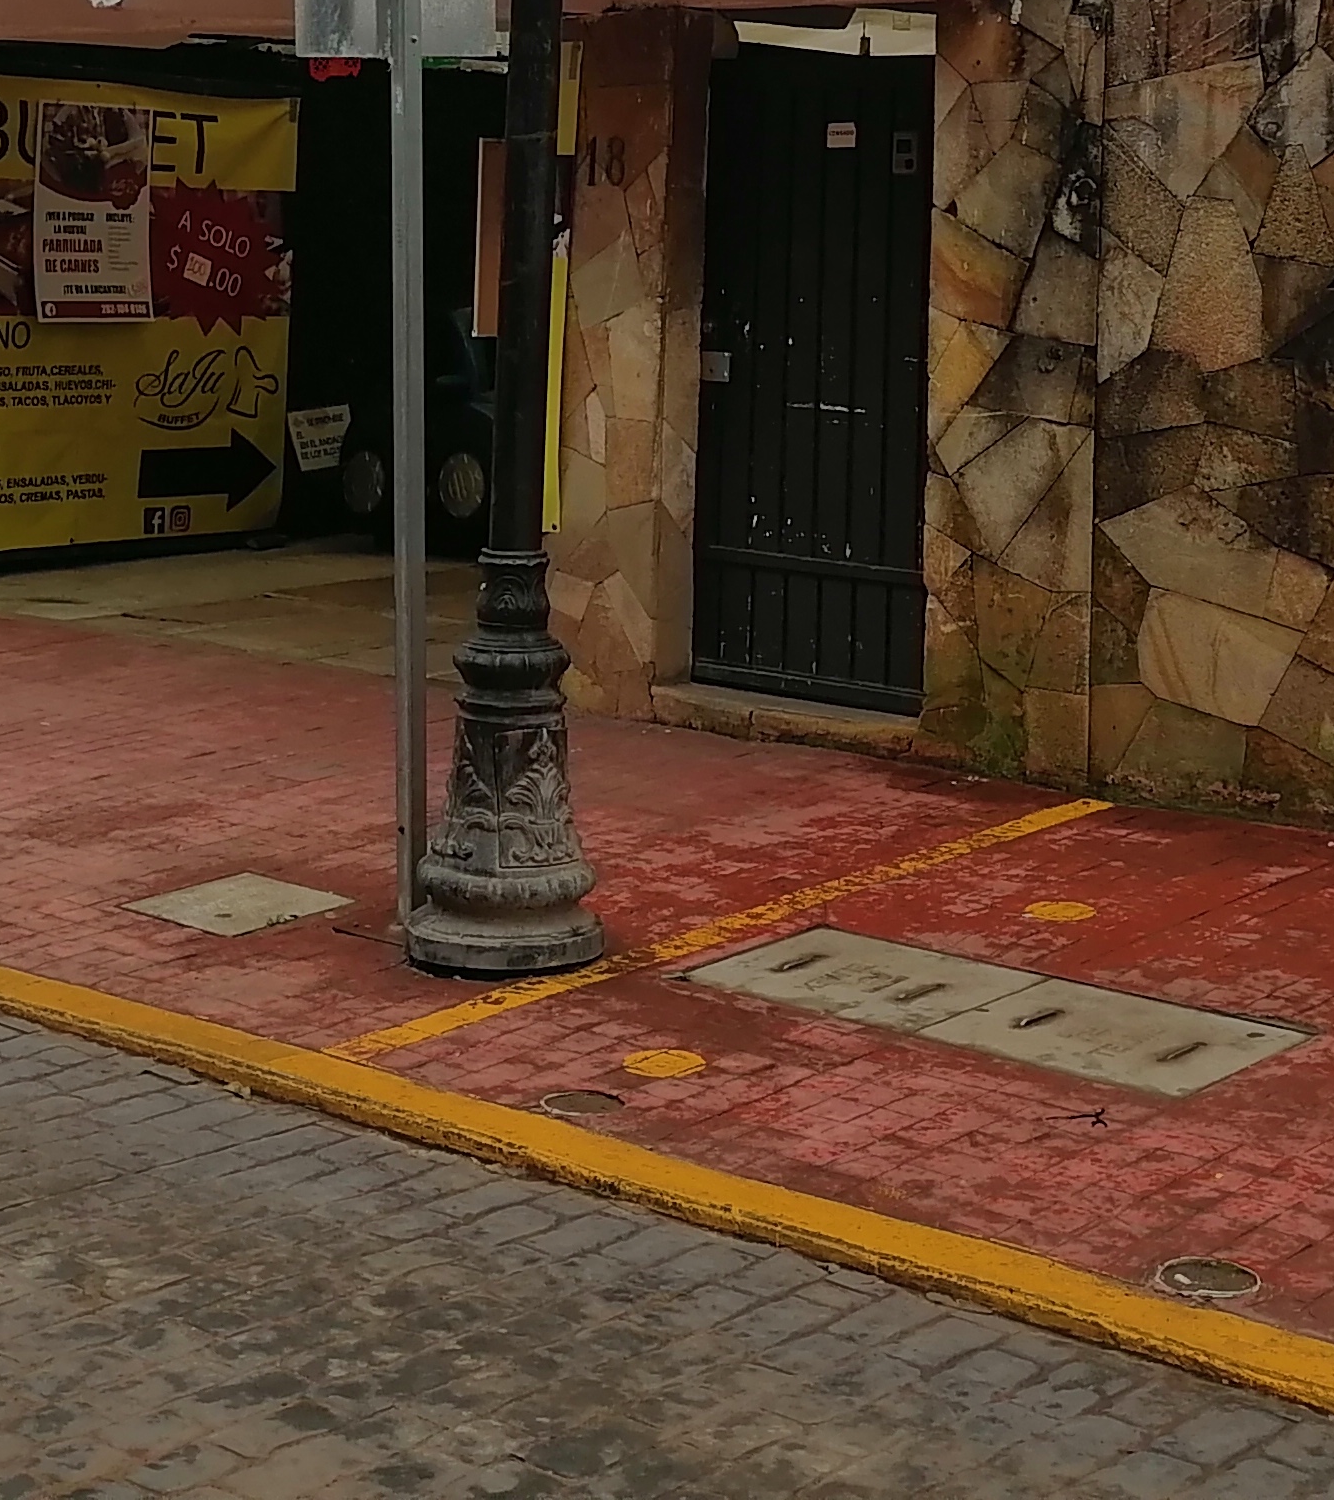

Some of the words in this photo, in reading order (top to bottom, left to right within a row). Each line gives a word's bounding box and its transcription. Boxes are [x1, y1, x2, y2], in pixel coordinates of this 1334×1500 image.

[586, 135, 625, 186] 18
[178, 211, 190, 232] A
[199, 220, 250, 257] SOLO
[42, 239, 103, 253] PARRILLADA
[167, 244, 181, 271] $
[45, 259, 57, 272] DE
[60, 259, 99, 273] CARNES
[11, 395, 49, 407] TACOS,
[52, 394, 102, 406] TLACOYOS
[104, 394, 112, 404] Y
[157, 411, 201, 425] BUFFET
[7, 475, 69, 489] ENSALADAS,
[71, 473, 108, 485] VERDU-
[19, 491, 63, 502] CREMAS,
[66, 488, 105, 500] PASTAS,
